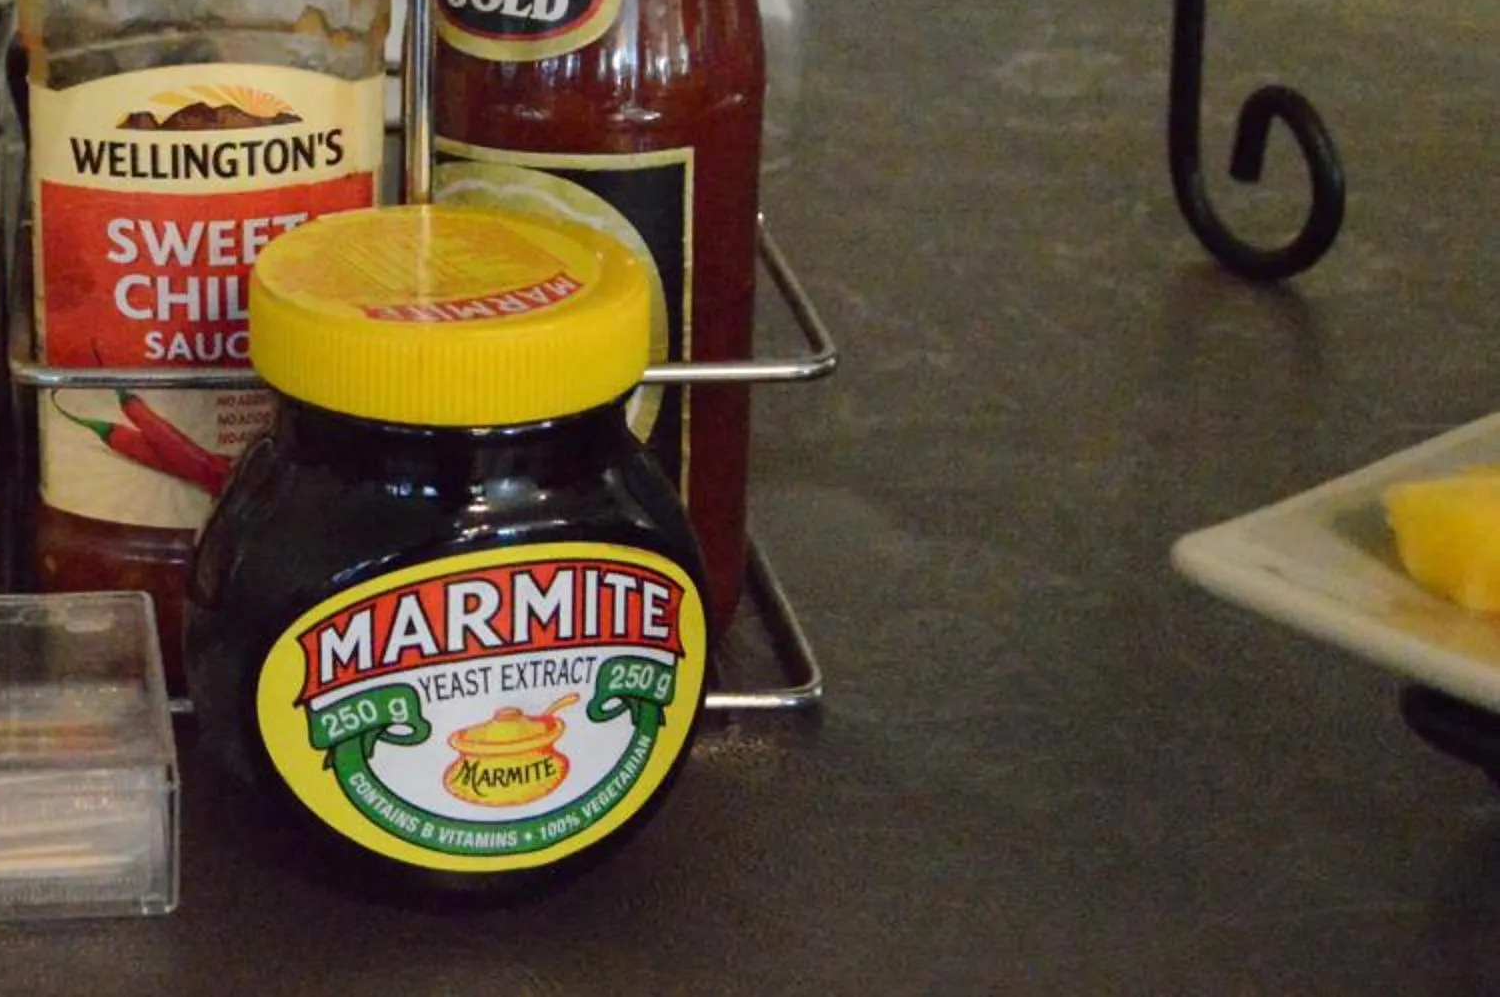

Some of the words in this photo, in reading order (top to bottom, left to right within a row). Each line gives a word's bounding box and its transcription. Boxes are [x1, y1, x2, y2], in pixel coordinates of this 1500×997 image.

[70, 129, 344, 180] WELLINGTON'S
[113, 274, 250, 323] CHIL
[144, 331, 250, 361] SAUC
[319, 568, 671, 684] MARMITE
[417, 666, 492, 703] YEAST
[501, 655, 598, 693] EXTRACT
[609, 663, 654, 691] 250
[653, 671, 672, 701] g
[319, 702, 376, 740] 250
[387, 695, 410, 723] g
[348, 771, 418, 833] CONTAINS
[420, 824, 436, 839] B
[436, 828, 518, 848] VITAMINS
[538, 815, 582, 841] 100%
[580, 734, 653, 819] VEGETARIAN
